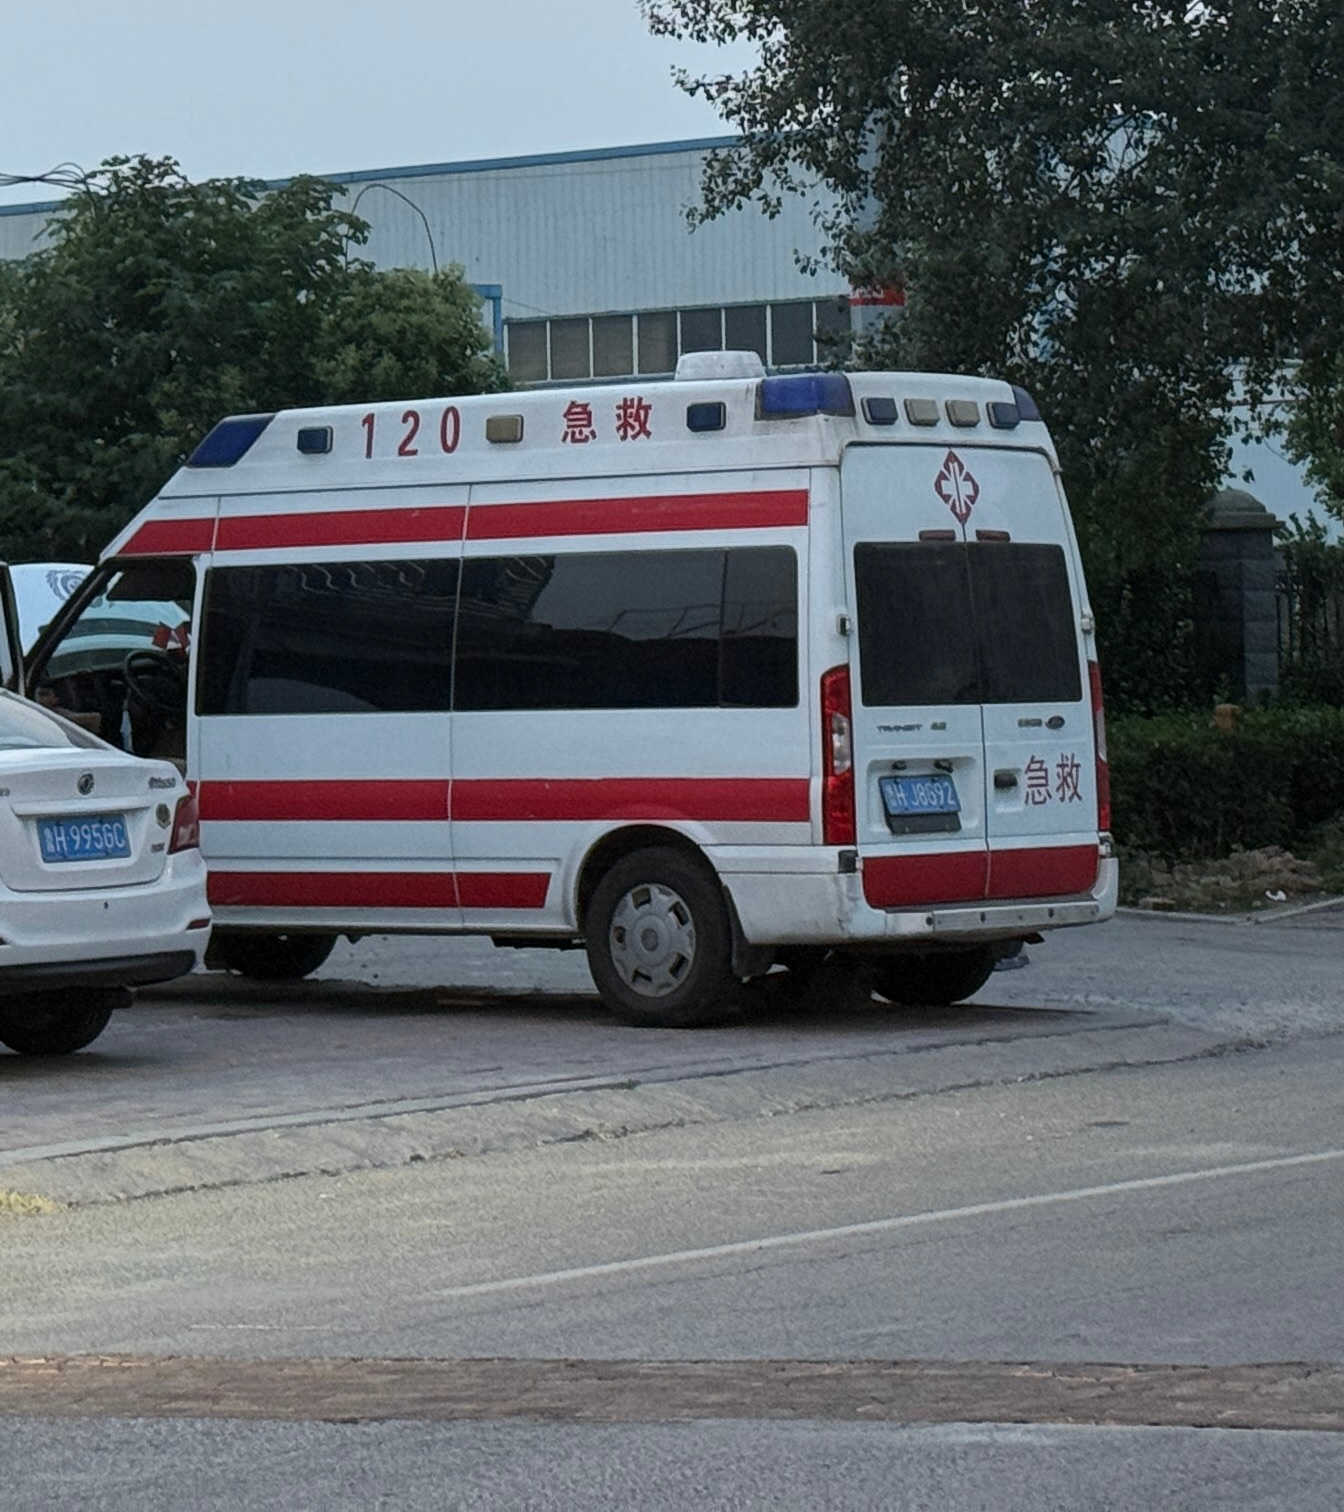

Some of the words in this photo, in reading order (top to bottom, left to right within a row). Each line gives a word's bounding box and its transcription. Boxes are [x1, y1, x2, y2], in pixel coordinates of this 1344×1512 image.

[361, 405, 461, 459] 120
[561, 396, 653, 444] 急救
[1024, 752, 1082, 806] 急救
